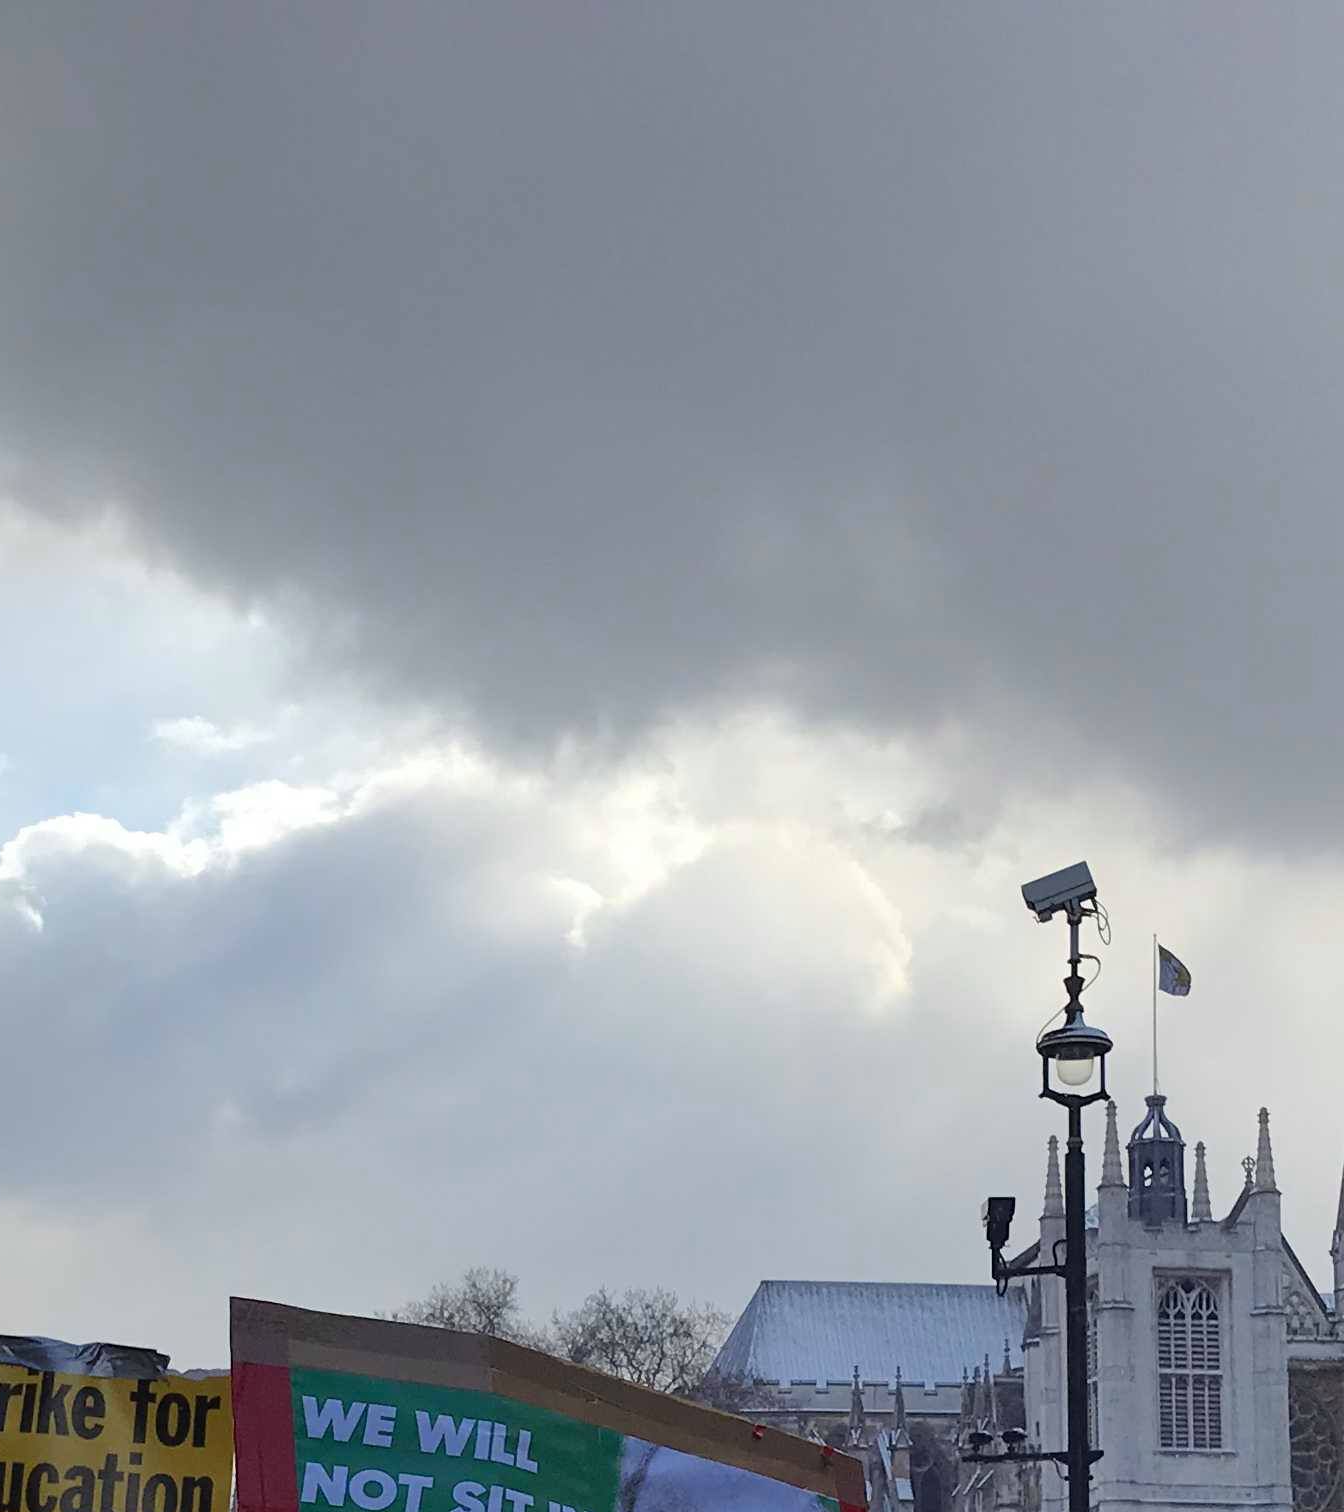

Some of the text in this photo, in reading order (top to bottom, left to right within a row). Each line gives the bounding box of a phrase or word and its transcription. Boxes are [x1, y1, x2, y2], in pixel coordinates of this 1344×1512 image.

[130, 1378, 221, 1449] for
[301, 1394, 540, 1475] WE WILL
